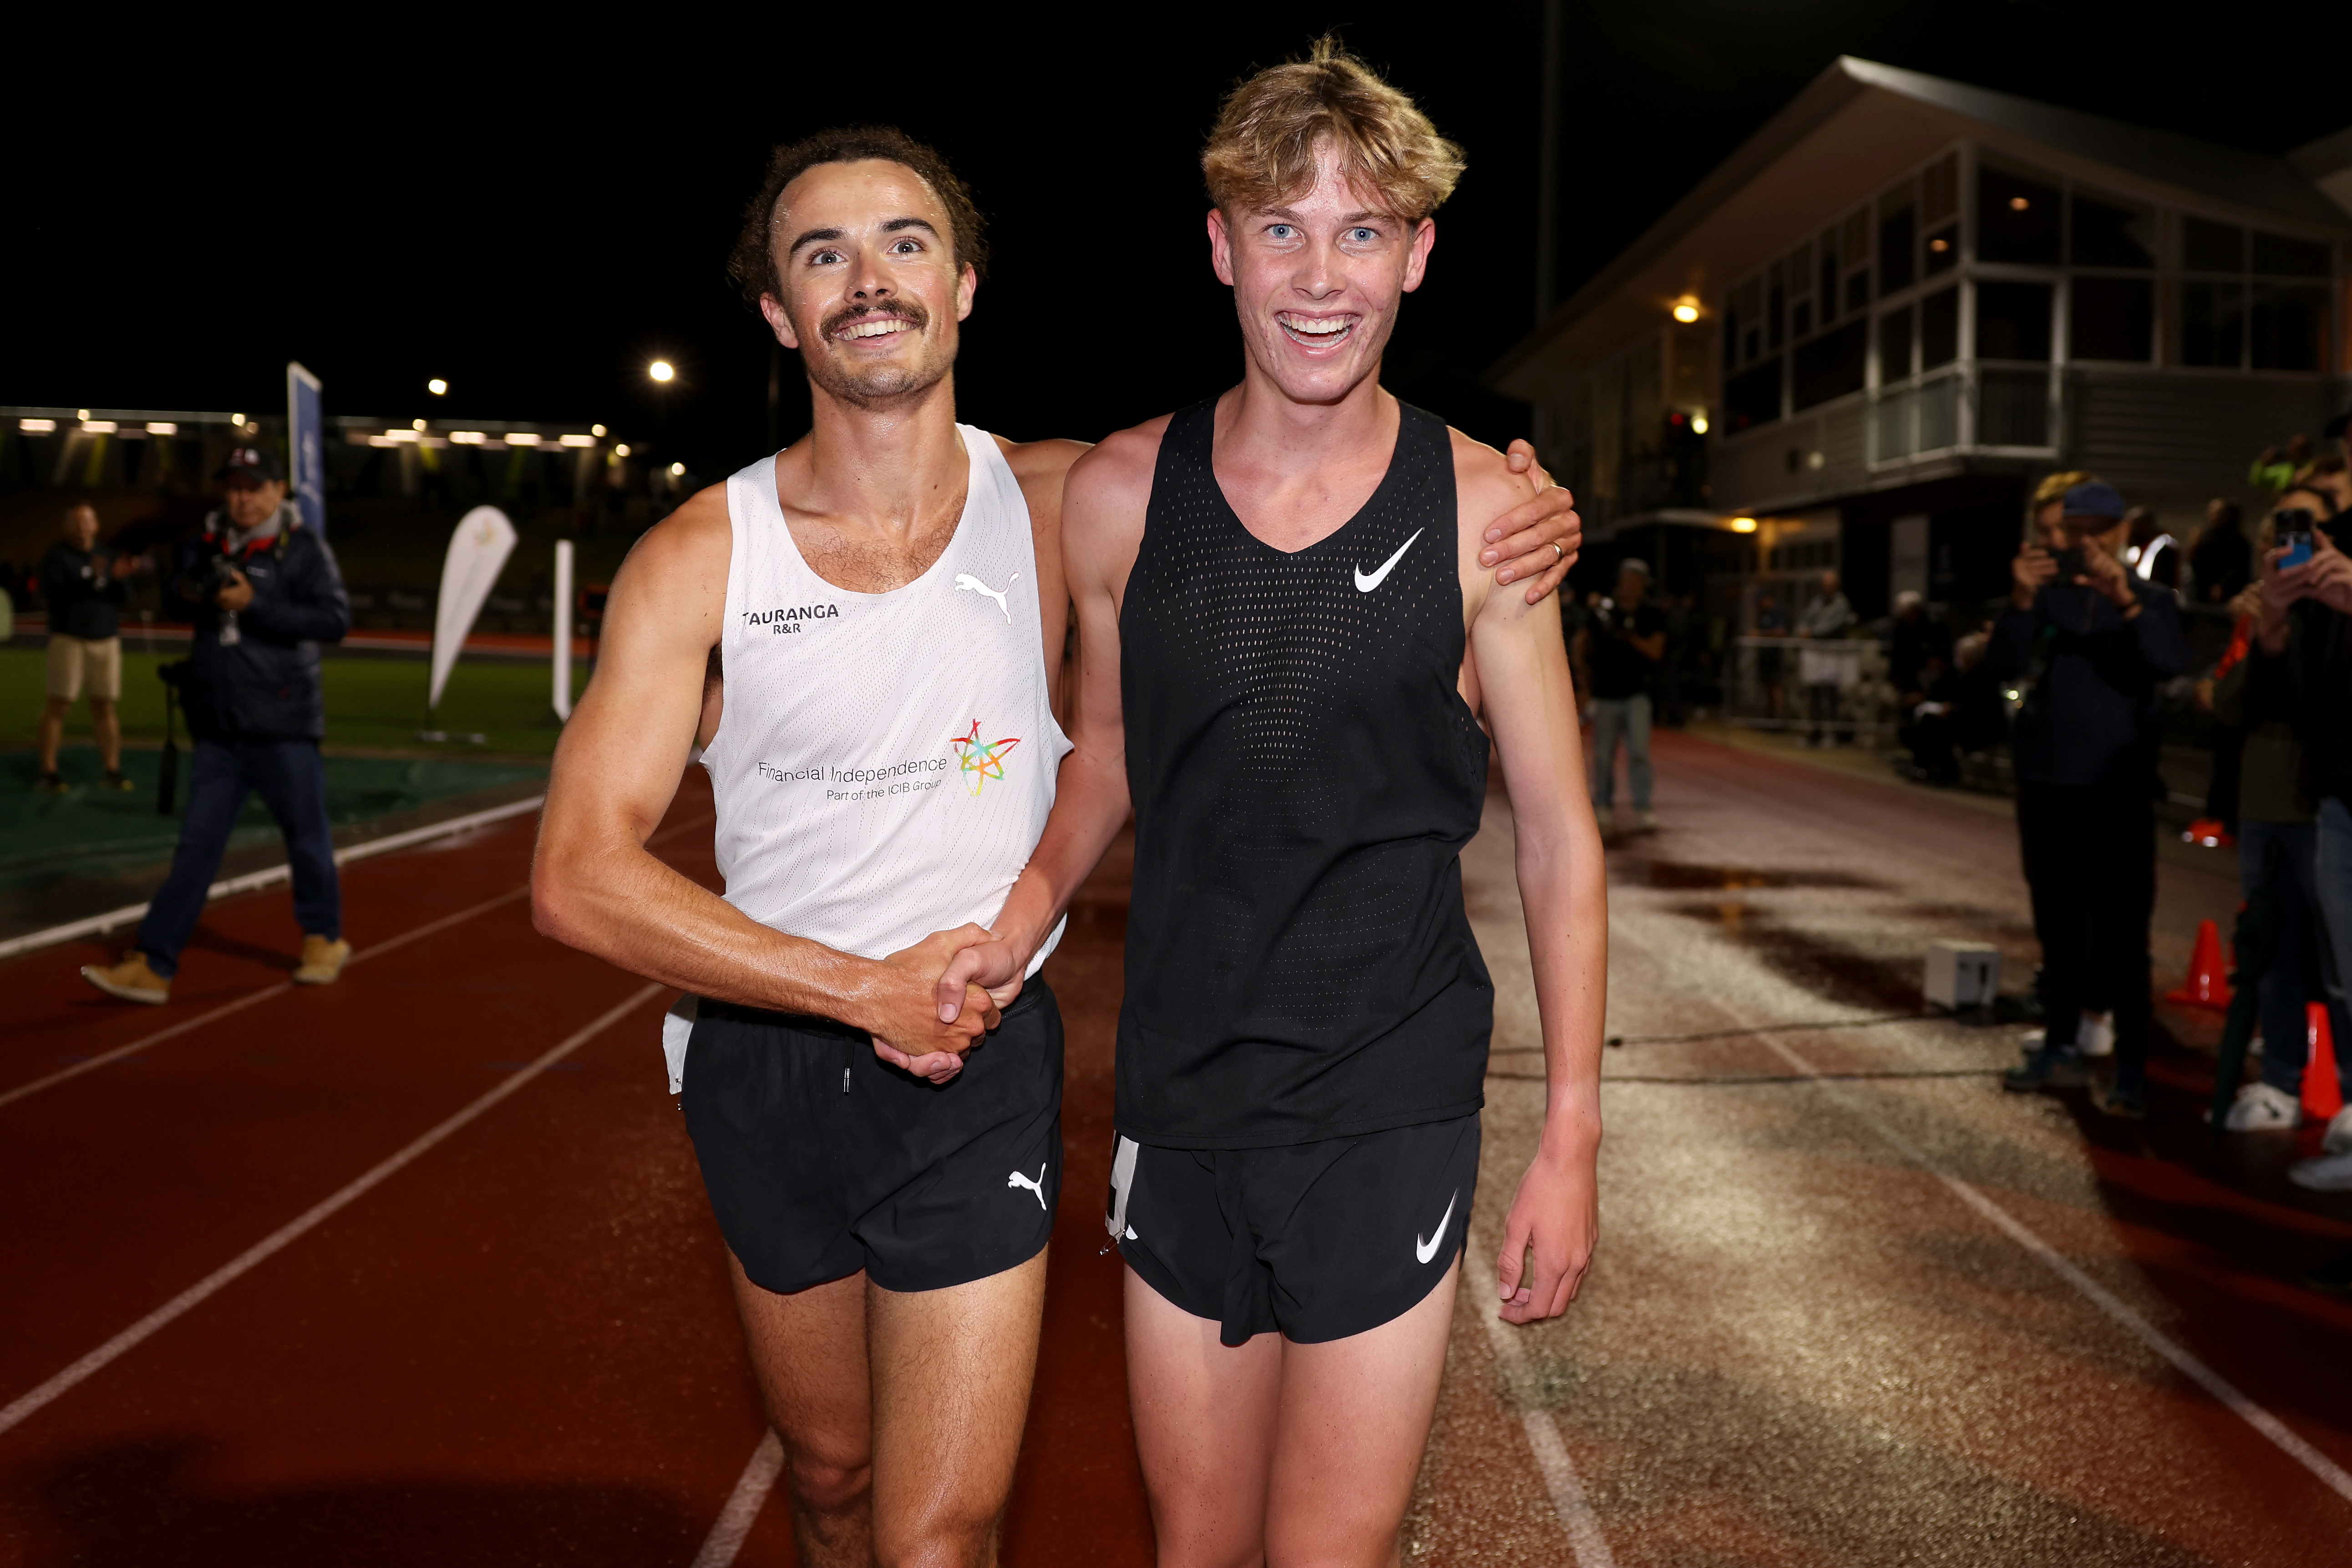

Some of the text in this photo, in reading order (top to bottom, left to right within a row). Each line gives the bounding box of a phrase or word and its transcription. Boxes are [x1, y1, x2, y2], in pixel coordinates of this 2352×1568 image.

[773, 623, 801, 634] R&R
[759, 758, 947, 785] Financial Independence
[827, 779, 942, 801] Part of the ICIB Group
